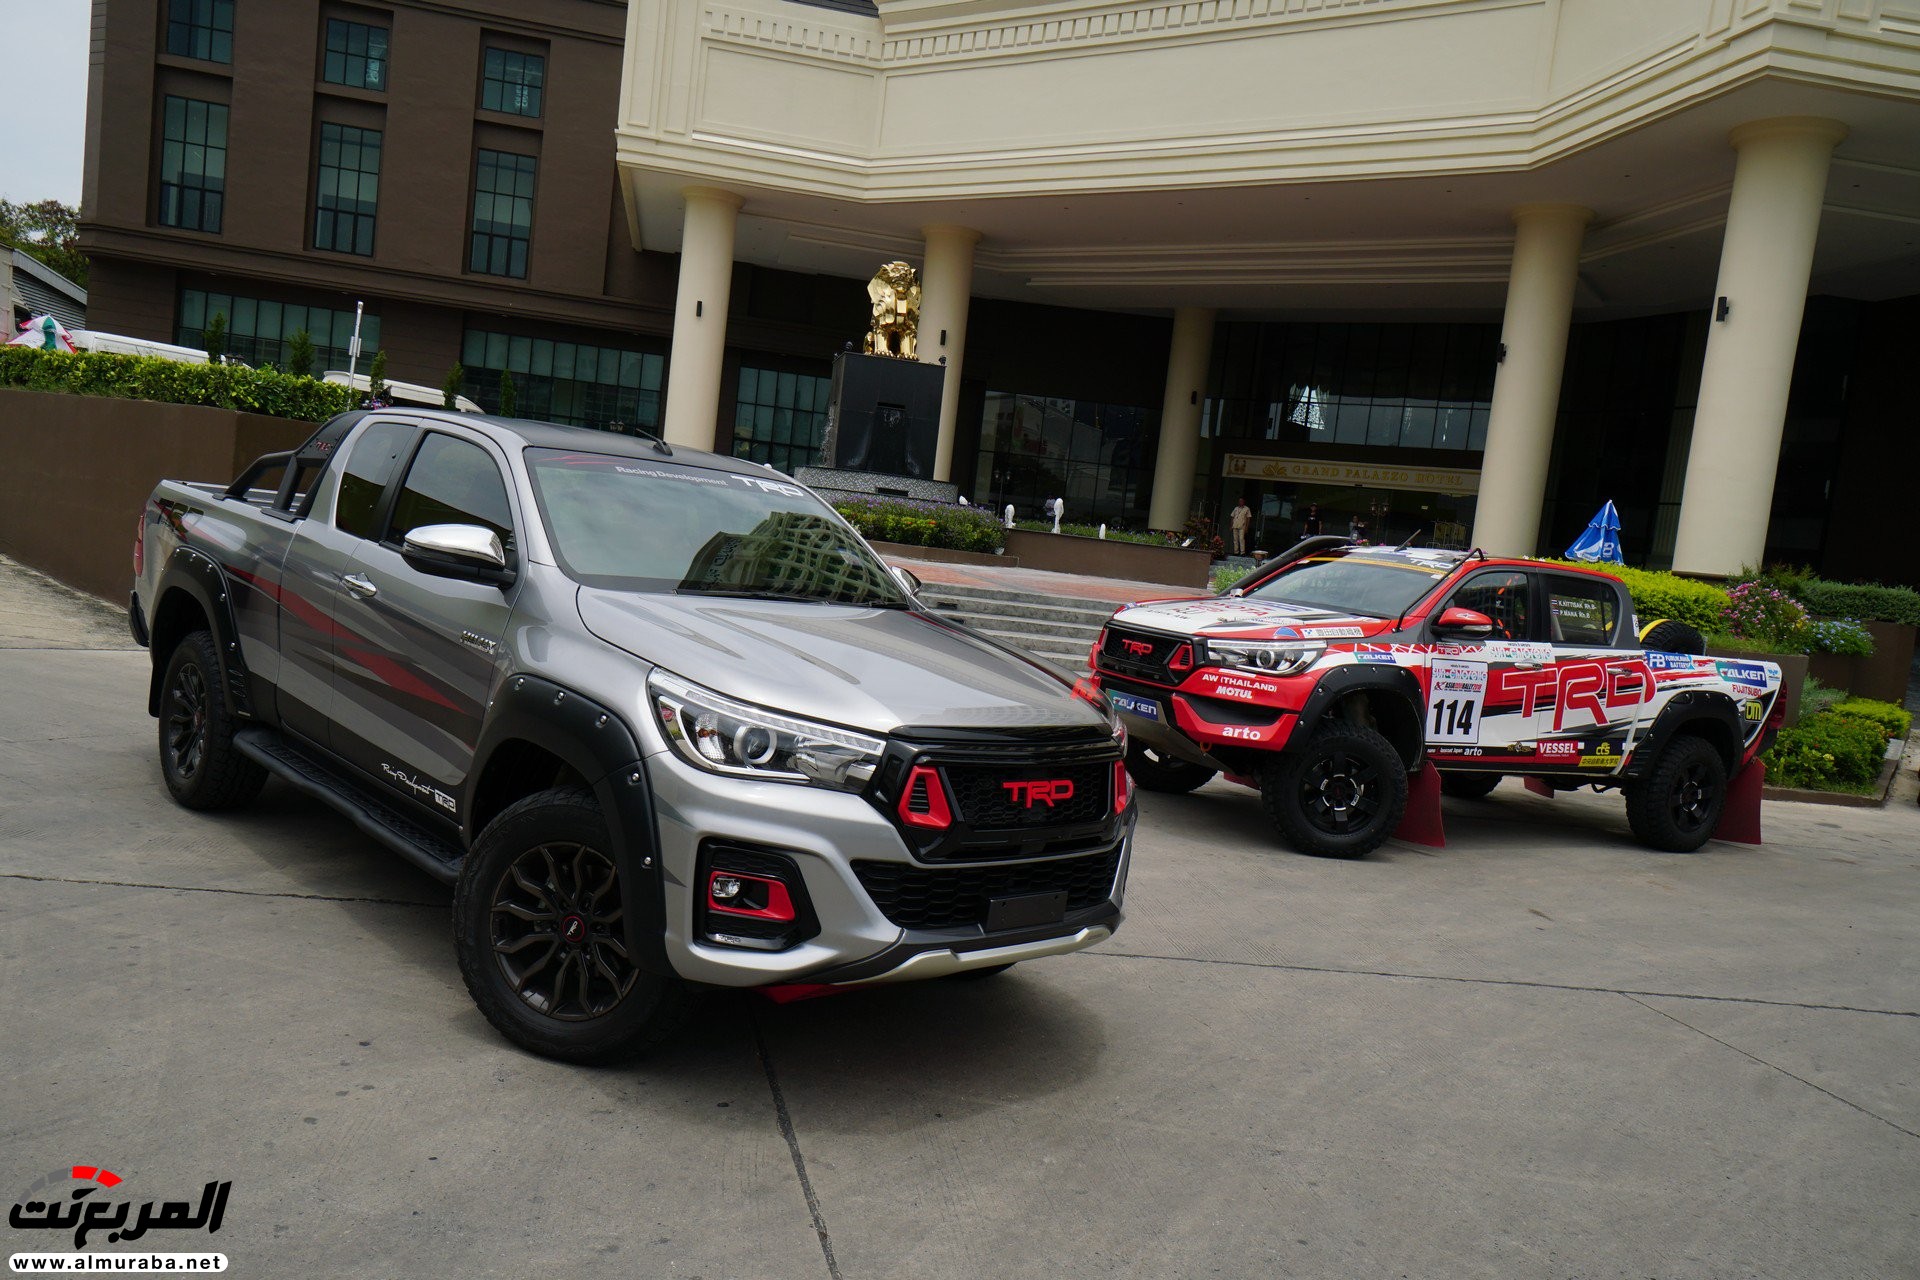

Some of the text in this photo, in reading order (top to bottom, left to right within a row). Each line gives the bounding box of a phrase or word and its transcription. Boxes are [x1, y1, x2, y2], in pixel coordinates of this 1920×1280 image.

[614, 466, 729, 487] Racing Development
[1292, 465, 1464, 486] GRAND PALAZZO HOTEL
[730, 475, 804, 497] TRD
[1121, 638, 1153, 656] TRD
[1357, 652, 1396, 662] FALKEN
[1649, 653, 1666, 668] FB
[1202, 673, 1277, 693] AW (THAILAND)
[1719, 668, 1766, 682] FALKEN
[1215, 685, 1253, 699] MOTUL
[1502, 658, 1658, 732] TRD
[1112, 696, 1157, 715] FALKEN
[1432, 699, 1475, 735] 114
[1222, 726, 1261, 741] arto
[1464, 746, 1483, 756] arto
[1539, 742, 1576, 754] VESSEL
[1002, 779, 1074, 809] TRD
